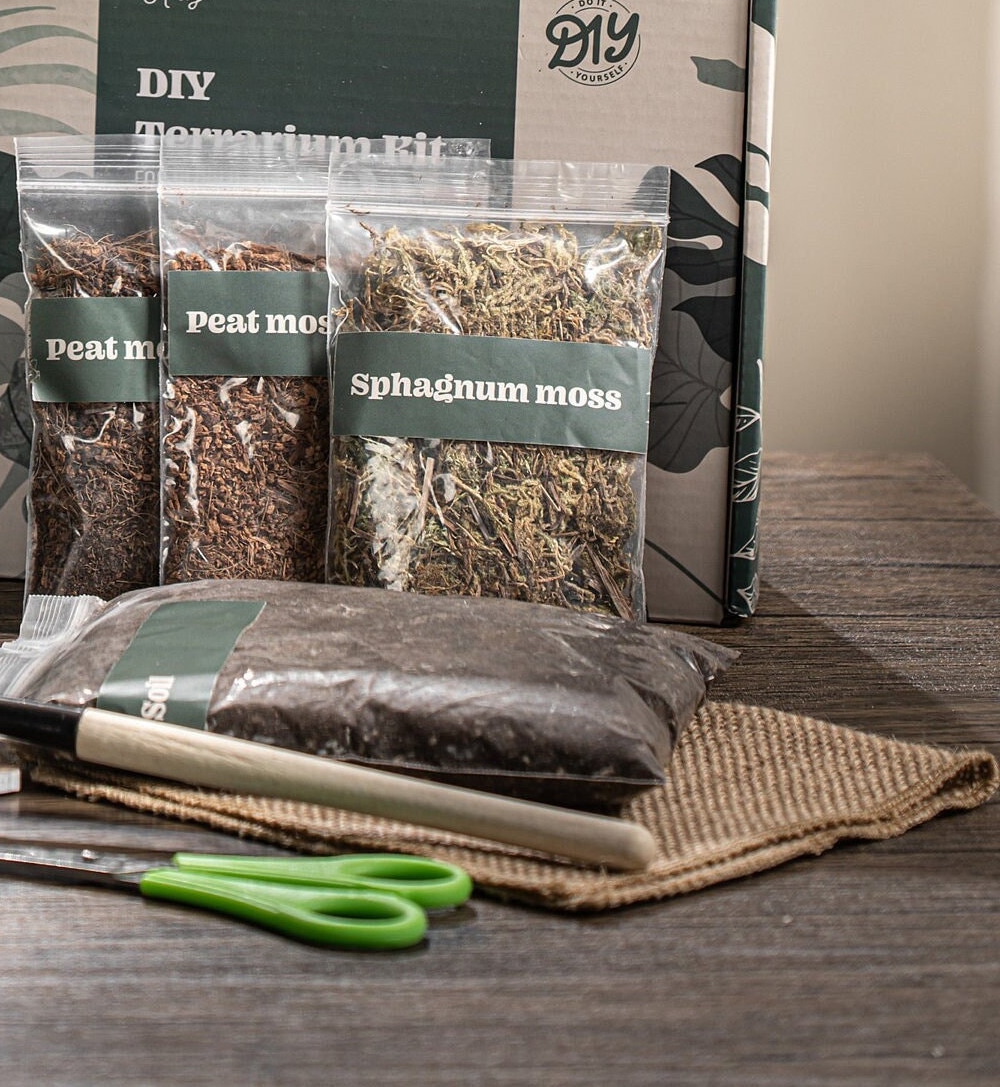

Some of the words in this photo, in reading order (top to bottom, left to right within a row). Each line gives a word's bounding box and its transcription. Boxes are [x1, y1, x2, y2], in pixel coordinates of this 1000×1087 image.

[545, 11, 640, 70] DIY
[136, 68, 216, 101] DIY
[575, 64, 624, 83] YOURSELF
[186, 309, 260, 334] Peat
[265, 313, 332, 334] mos
[45, 336, 118, 361] Peat
[350, 372, 530, 404] Sphagnum
[535, 383, 623, 411] moss
